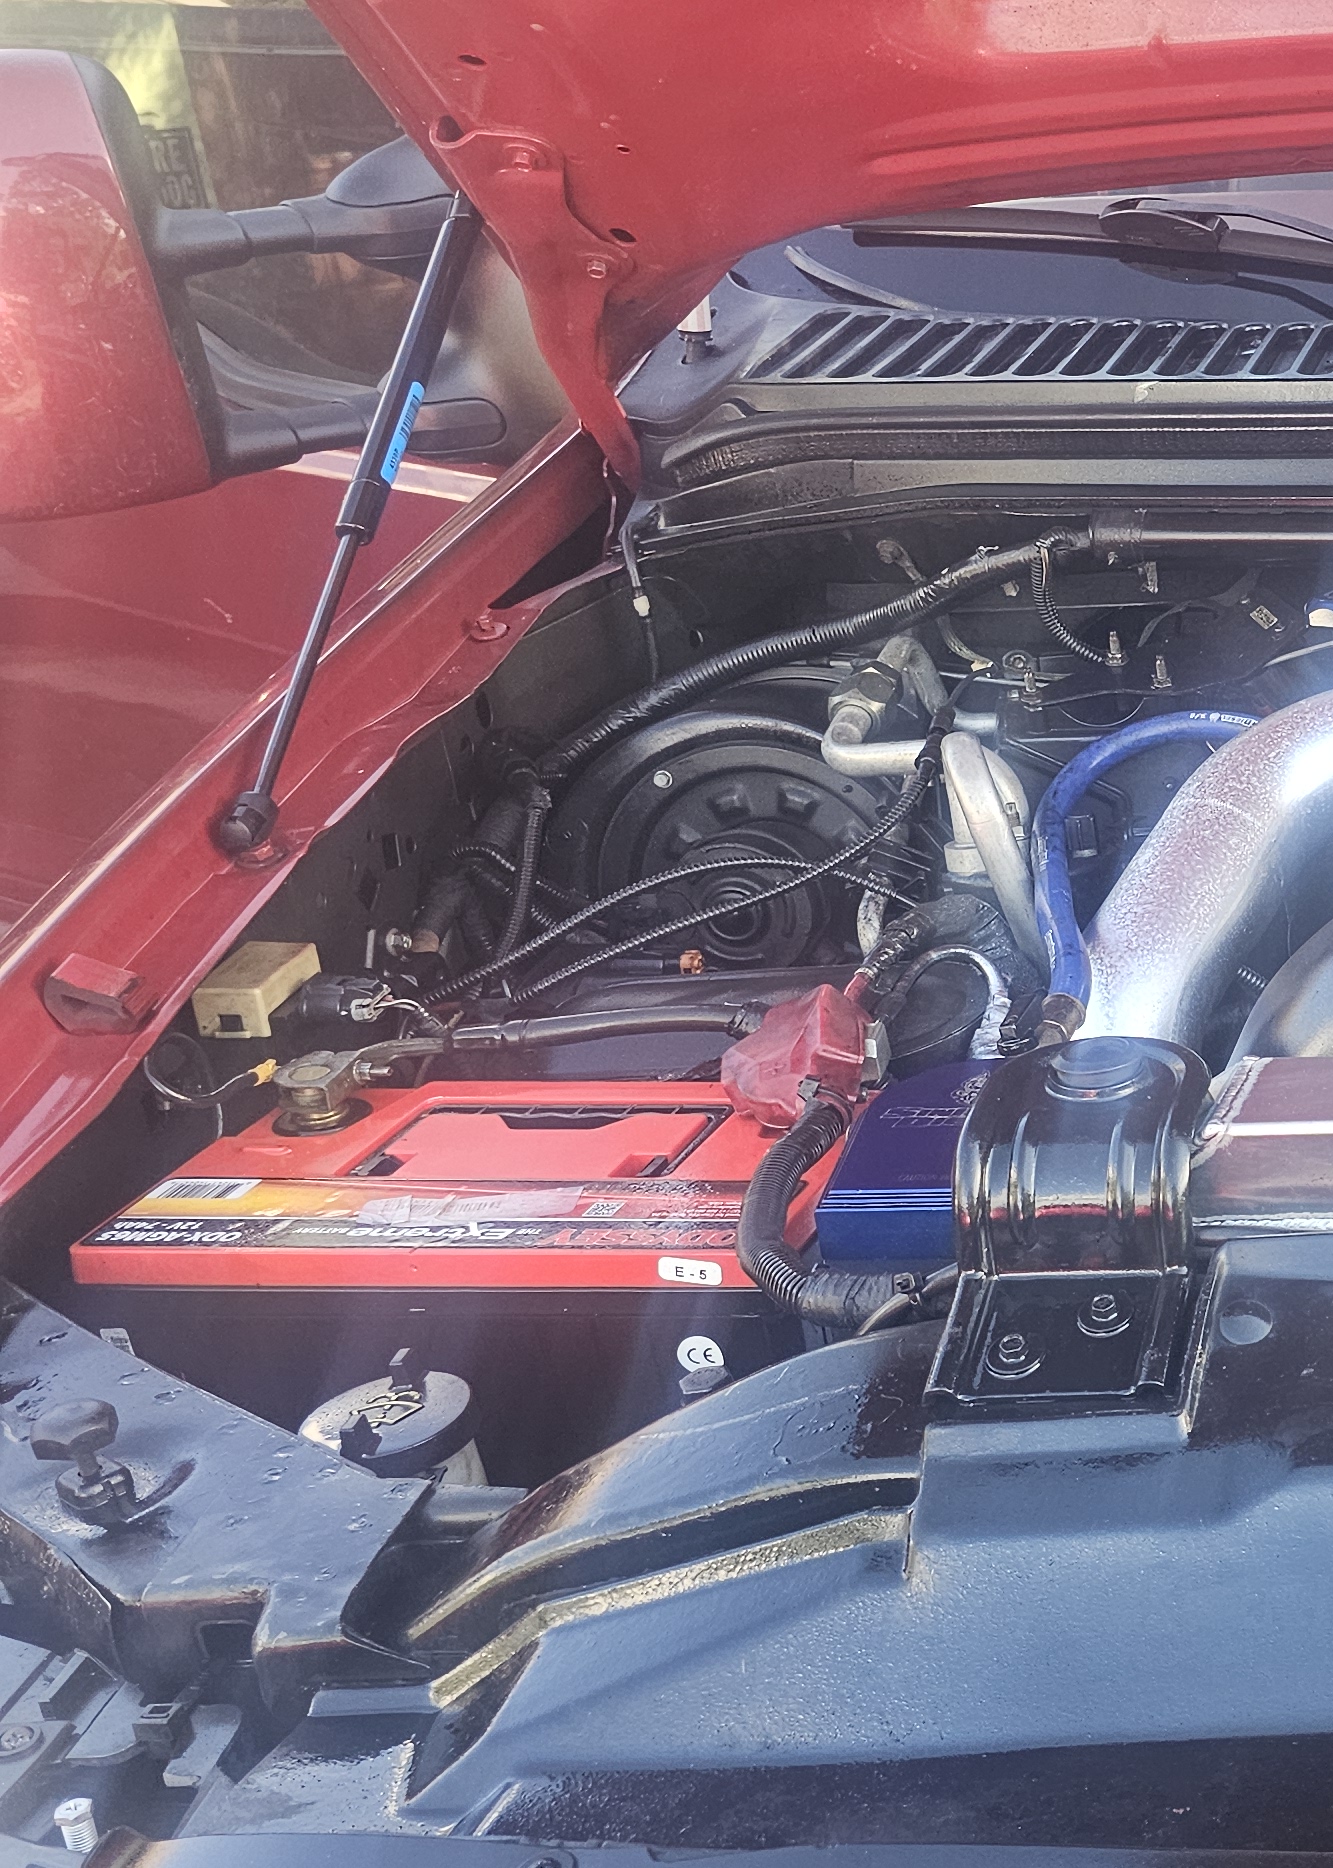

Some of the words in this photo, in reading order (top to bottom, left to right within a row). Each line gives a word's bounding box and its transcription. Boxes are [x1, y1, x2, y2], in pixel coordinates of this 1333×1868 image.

[113, 1221, 160, 1230] 74Ah
[168, 1221, 204, 1230] 12V
[349, 1221, 517, 1240] Extreme
[516, 1228, 543, 1236] THE
[95, 1230, 243, 1242] ODX-AGM65
[537, 1228, 737, 1246] ODYSSEY
[675, 1266, 684, 1277] E
[699, 1269, 707, 1280] 5
[687, 1347, 716, 1365] CE
